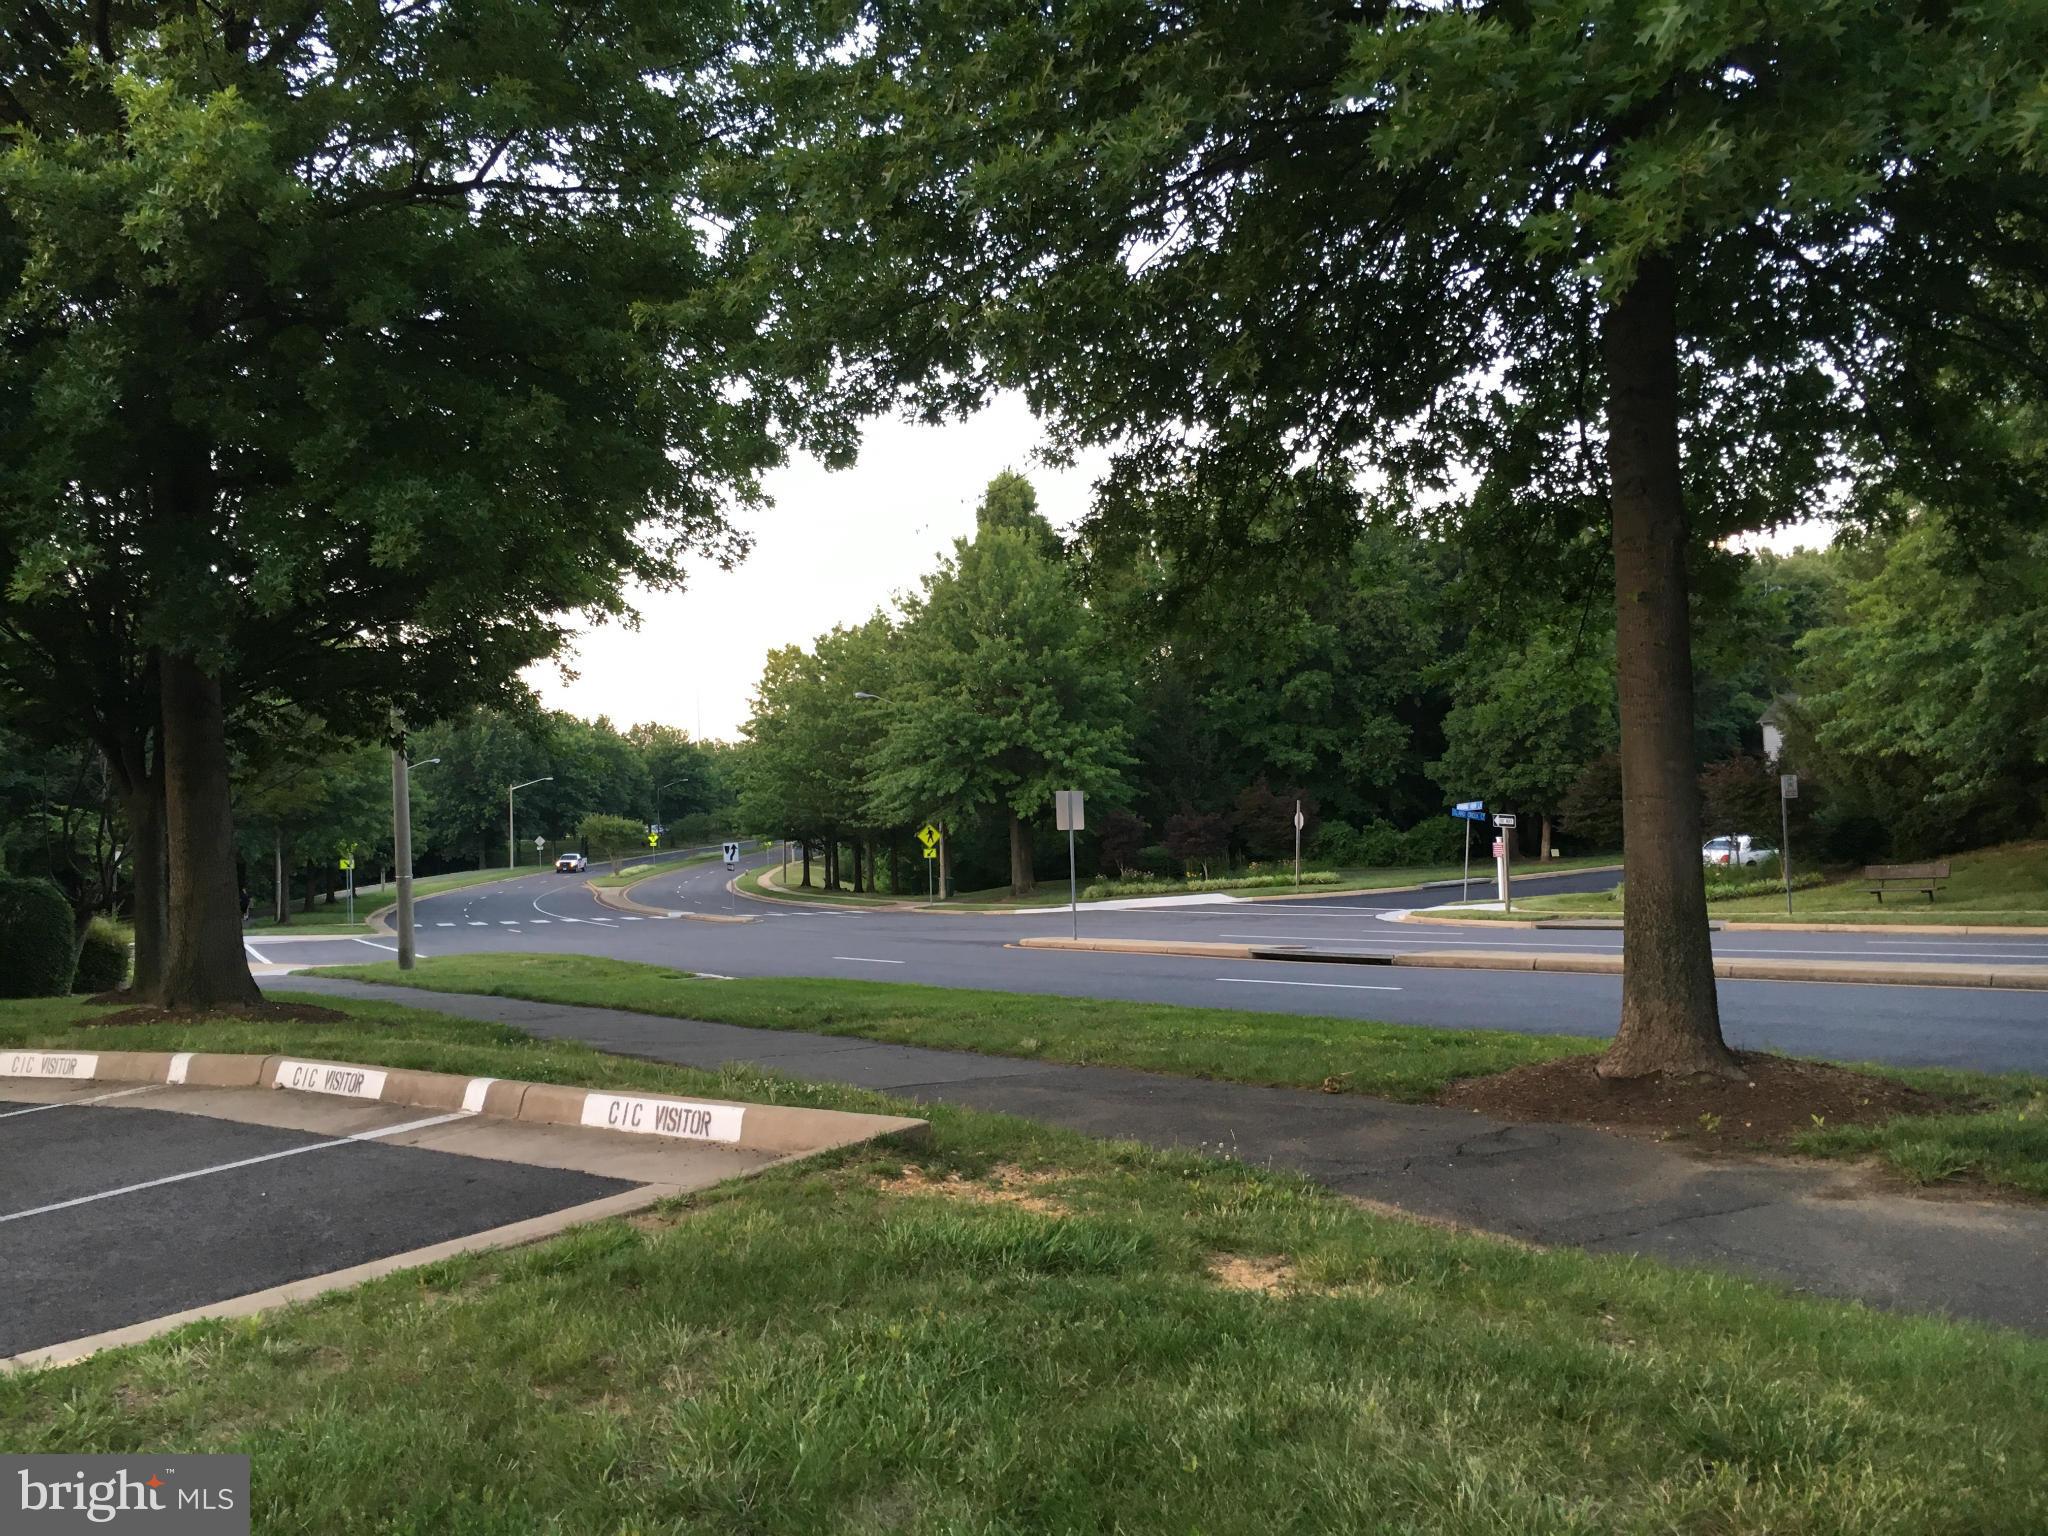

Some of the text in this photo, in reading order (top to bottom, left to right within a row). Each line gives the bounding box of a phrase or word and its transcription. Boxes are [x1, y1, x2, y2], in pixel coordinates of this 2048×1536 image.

[11, 1056, 77, 1075] CIC VISITOR
[293, 1067, 365, 1093] CIC VISITOR
[608, 1101, 712, 1136] CIC VISITOR
